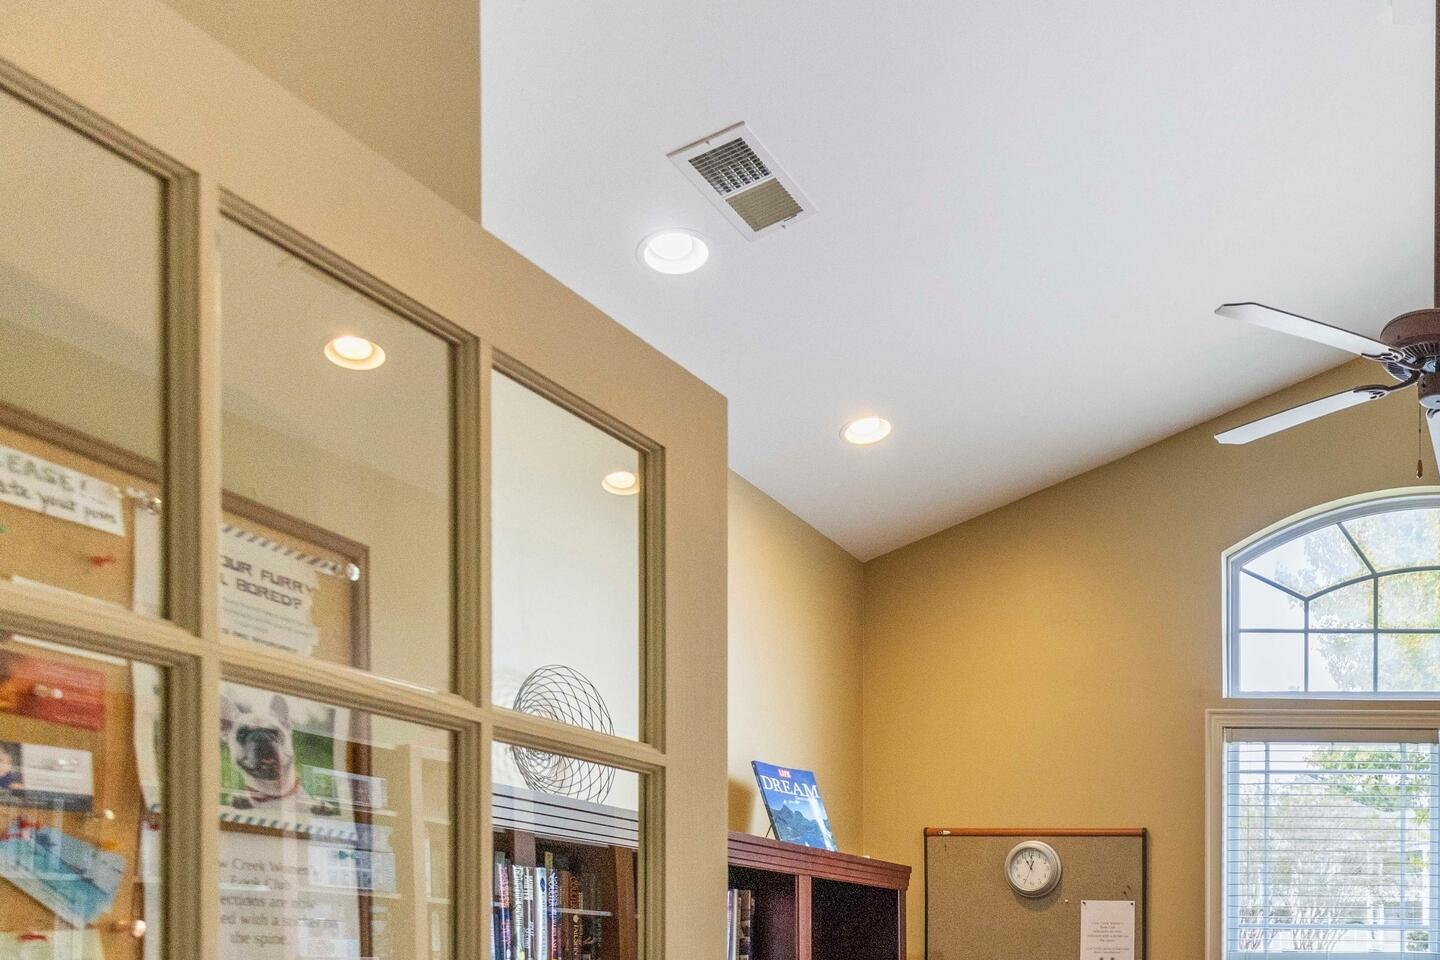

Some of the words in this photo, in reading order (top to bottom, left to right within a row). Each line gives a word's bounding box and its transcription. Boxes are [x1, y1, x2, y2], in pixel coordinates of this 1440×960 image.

[0, 454, 87, 493] EASE!
[236, 578, 302, 609] BORED?
[260, 568, 315, 594] FURRY
[760, 775, 821, 798] DREAM
[219, 896, 265, 908] ections
